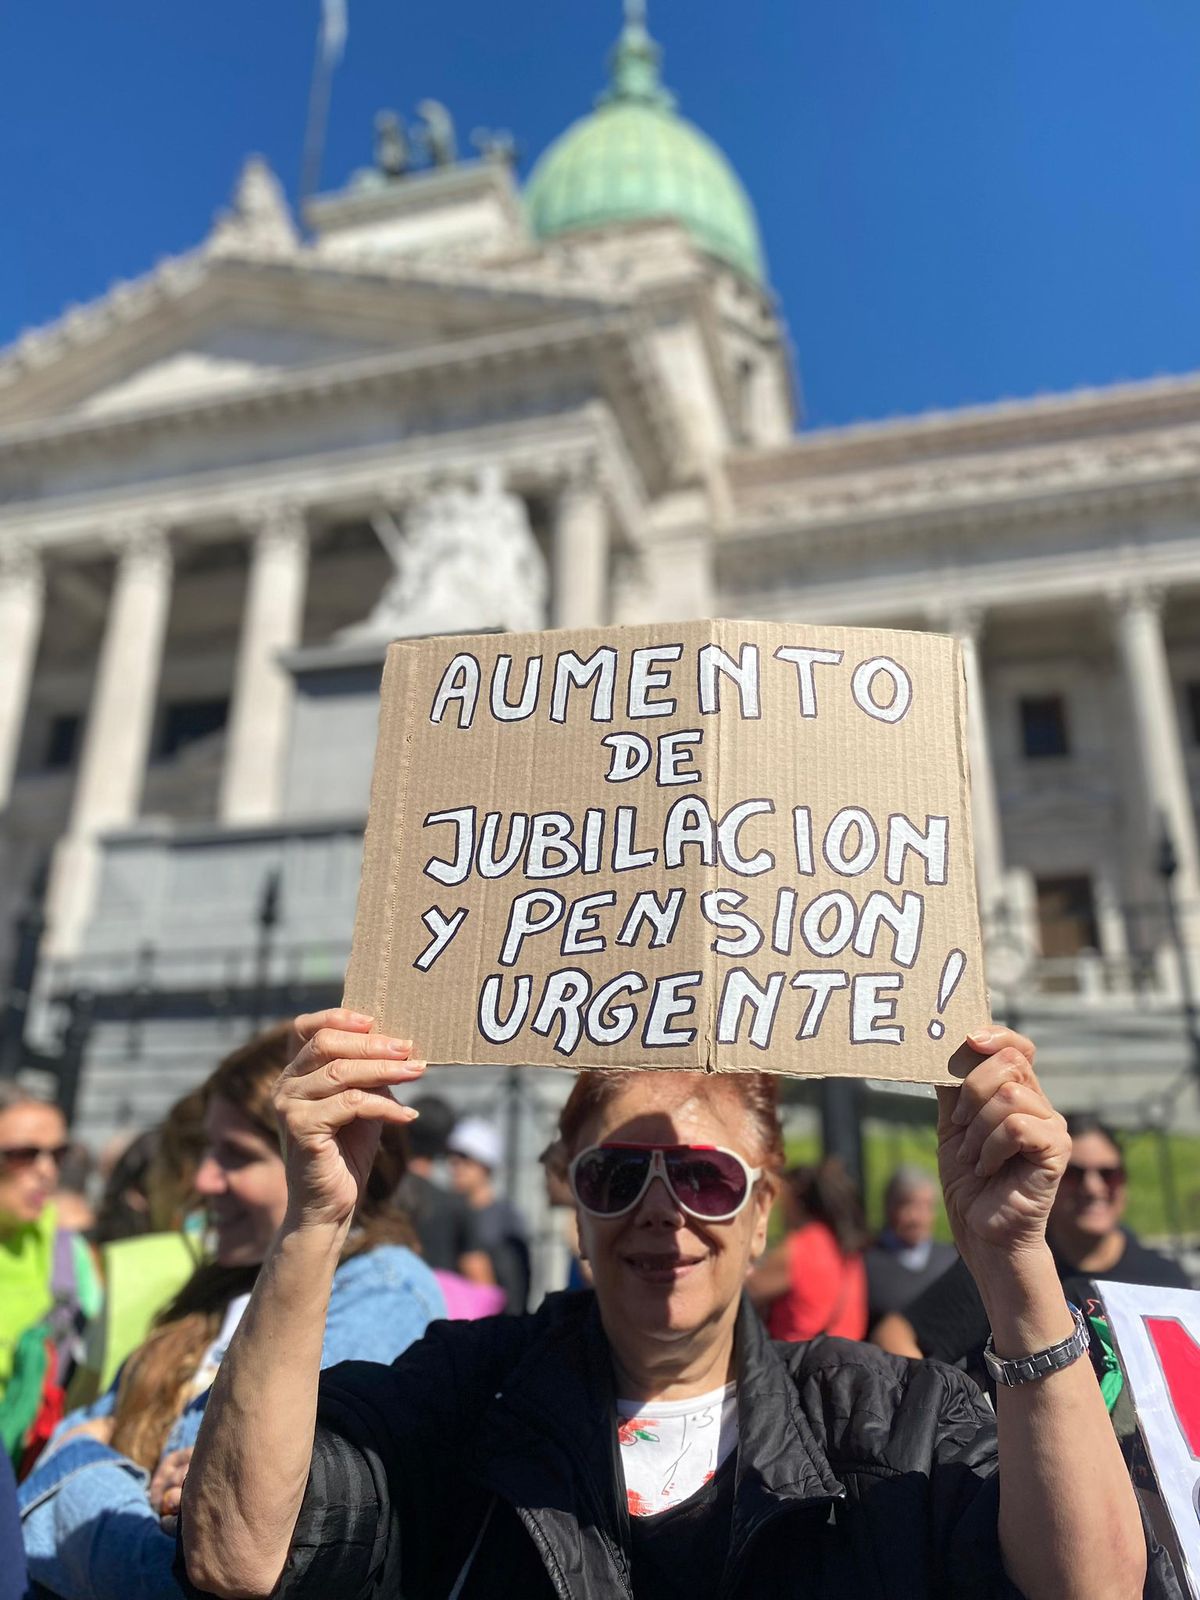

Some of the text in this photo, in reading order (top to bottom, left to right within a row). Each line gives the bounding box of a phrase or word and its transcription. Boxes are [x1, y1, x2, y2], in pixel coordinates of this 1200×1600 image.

[430, 643, 914, 729] AUMENTO
[602, 731, 705, 787] DE
[422, 795, 951, 886] JUBILACION
[499, 888, 925, 969] PENSION
